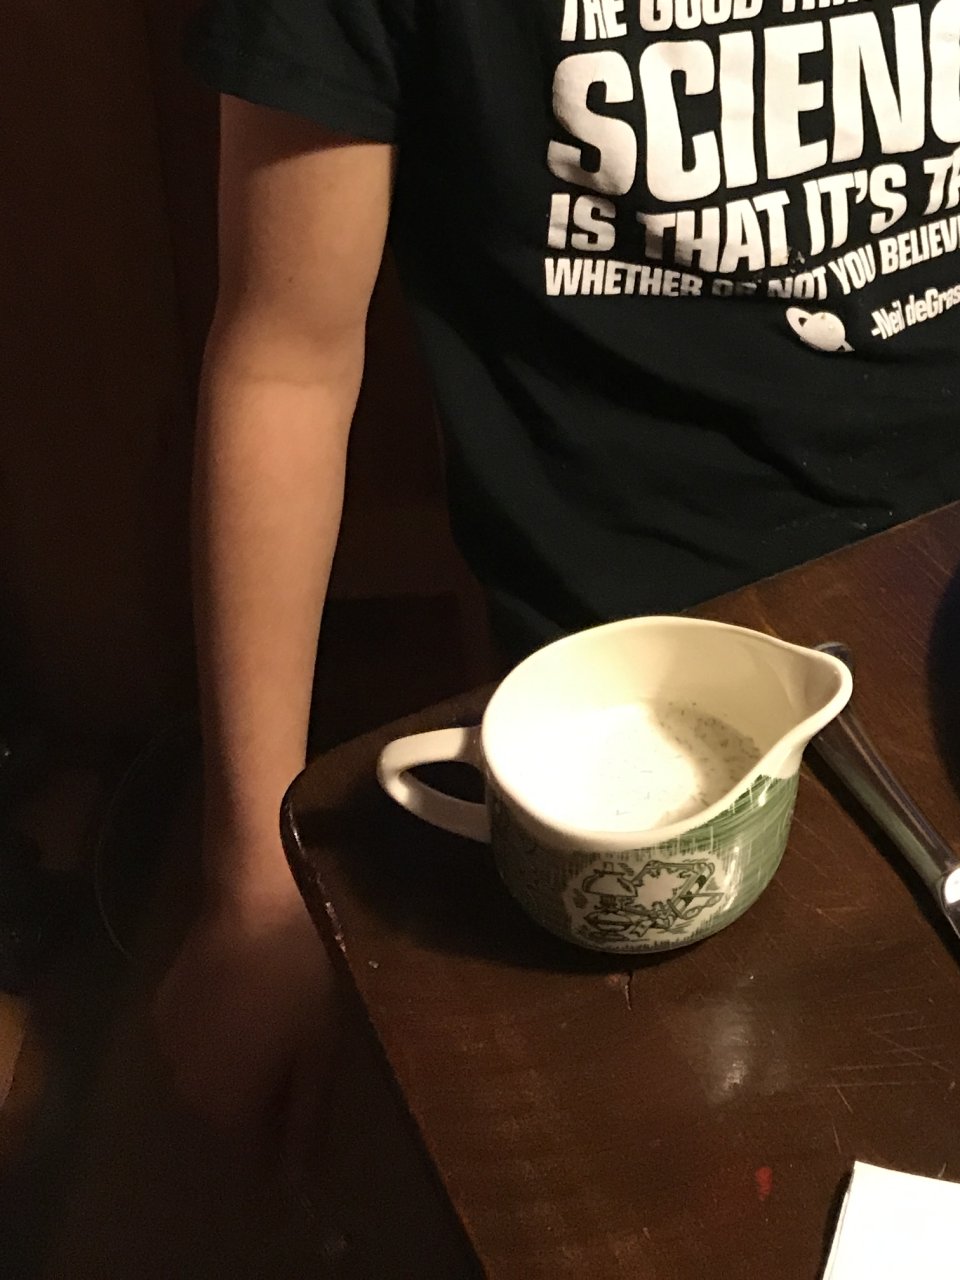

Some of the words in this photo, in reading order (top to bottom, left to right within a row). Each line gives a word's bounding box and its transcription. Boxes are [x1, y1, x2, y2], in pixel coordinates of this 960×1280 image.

[547, 193, 616, 251] IS
[636, 190, 790, 273] THAT
[803, 163, 907, 256] IT'S
[544, 257, 703, 296] WHETHER
[767, 266, 828, 300] NOT
[828, 243, 876, 295] YOU
